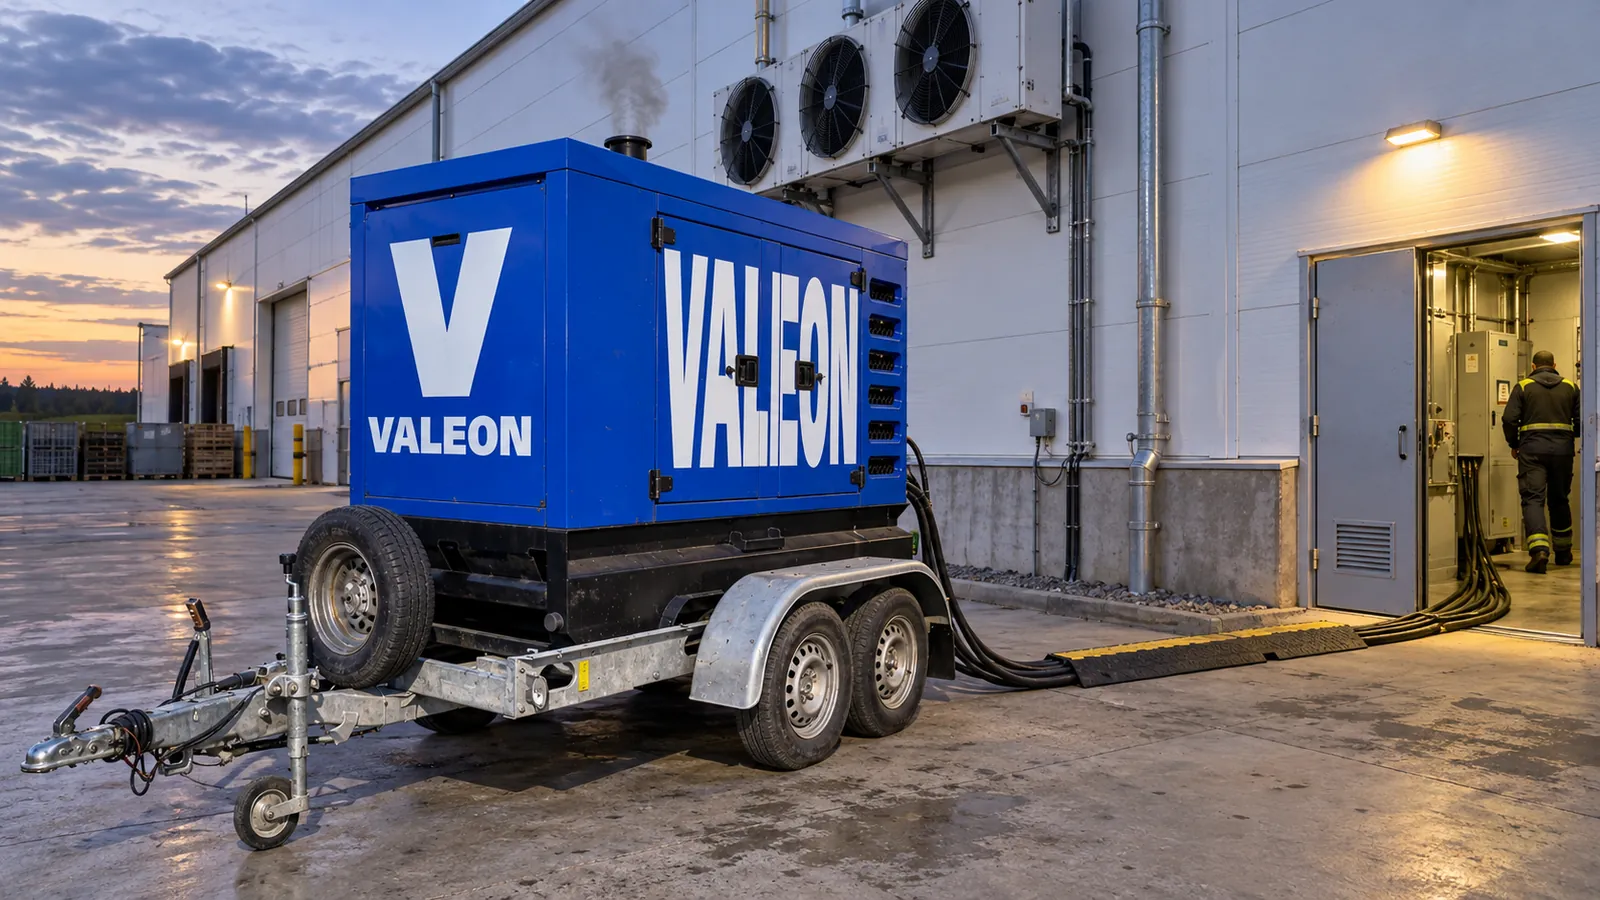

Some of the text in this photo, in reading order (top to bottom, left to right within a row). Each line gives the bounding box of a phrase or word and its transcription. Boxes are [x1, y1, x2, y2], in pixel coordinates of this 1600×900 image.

[390, 227, 513, 398] V
[664, 248, 859, 469] VALEON
[368, 415, 532, 457] VALEON
